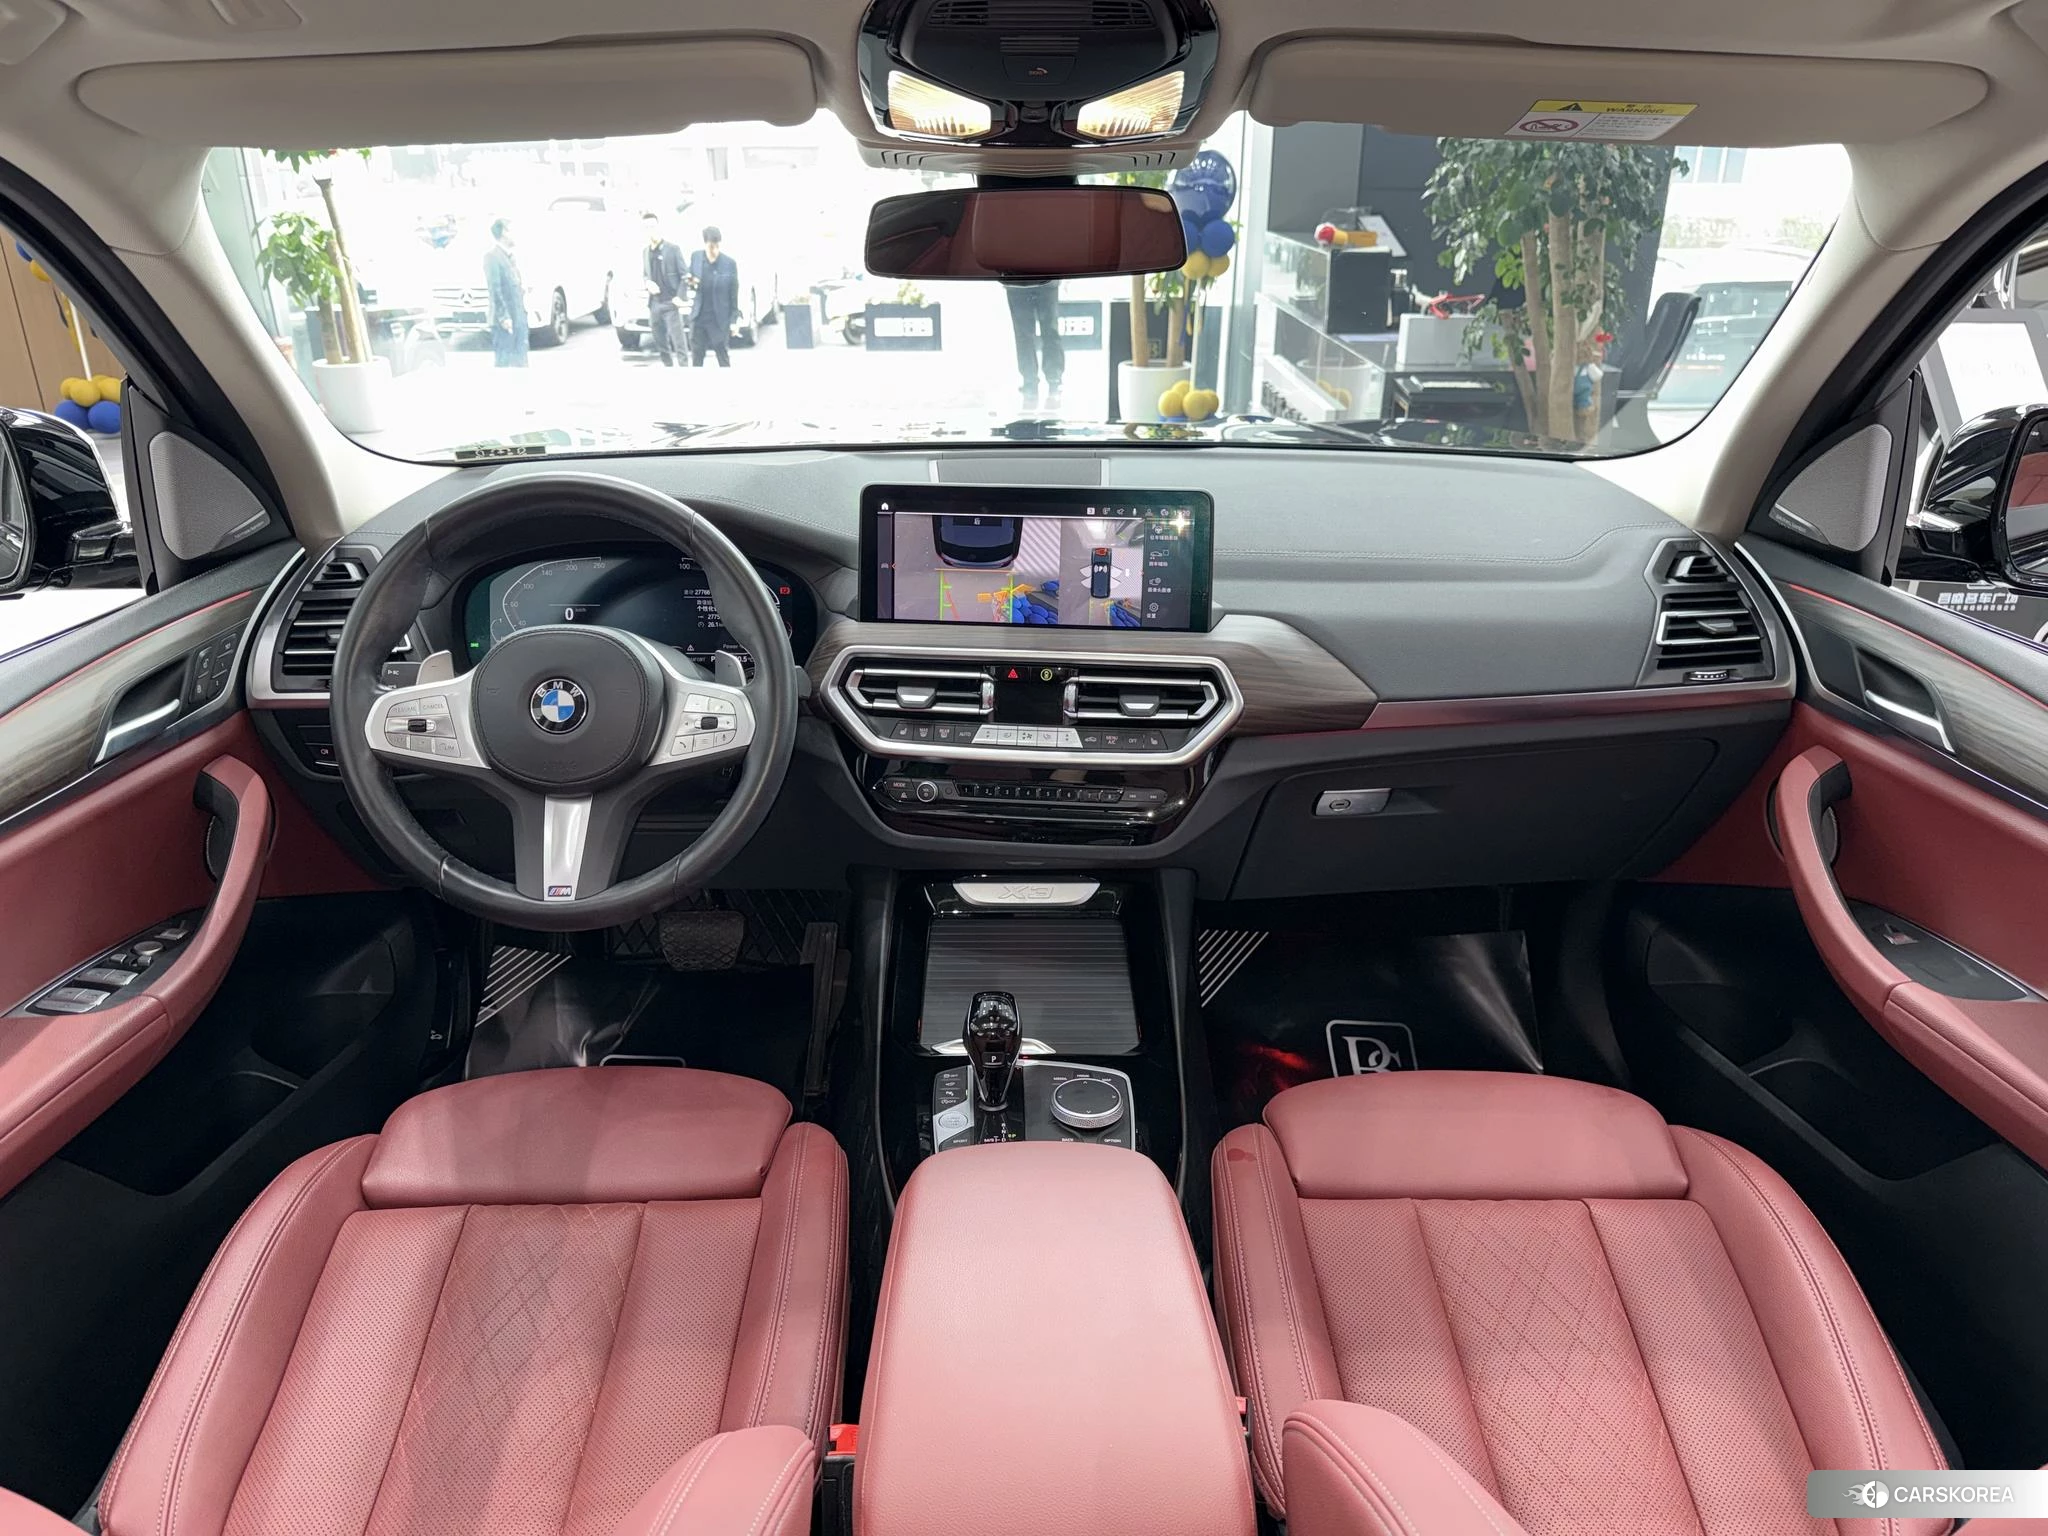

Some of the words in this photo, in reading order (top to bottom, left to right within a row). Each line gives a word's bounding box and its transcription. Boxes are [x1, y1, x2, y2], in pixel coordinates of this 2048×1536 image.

[564, 607, 574, 621] 0
[537, 681, 581, 698] BMW
[998, 886, 1054, 899] X3
[991, 1055, 997, 1063] P
